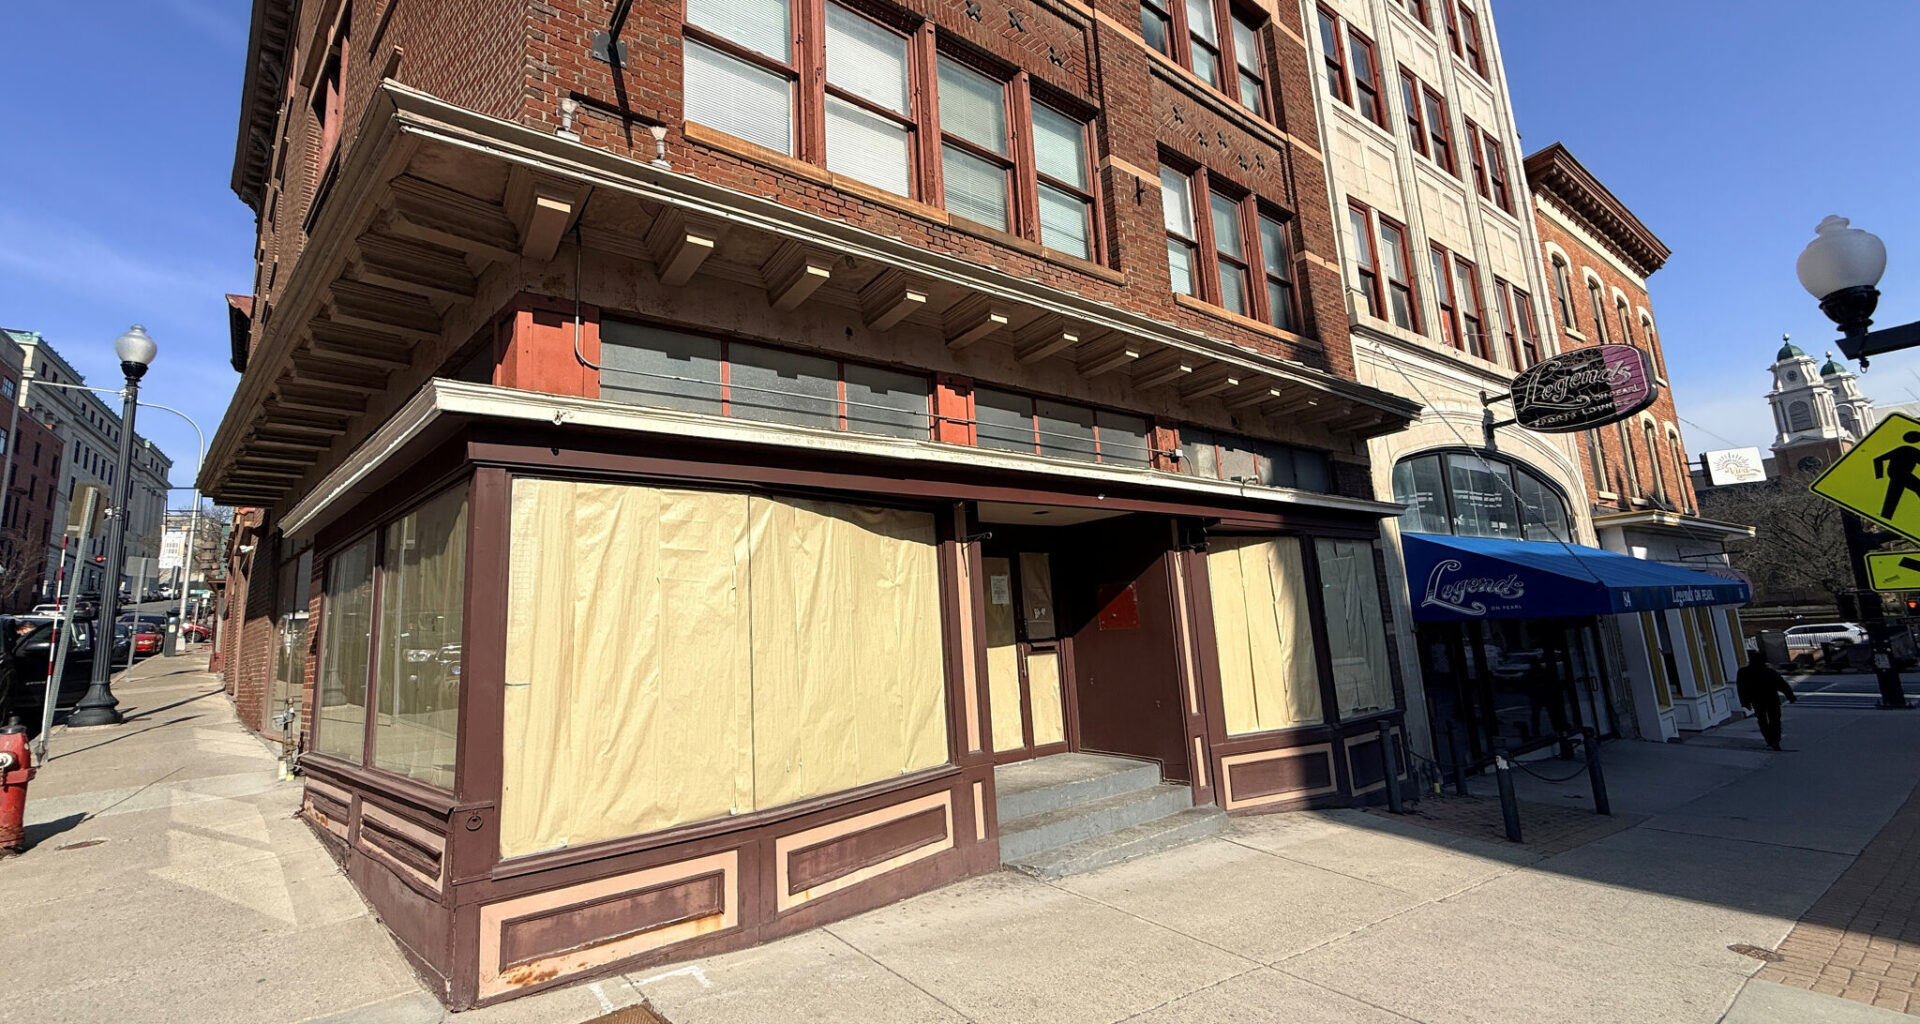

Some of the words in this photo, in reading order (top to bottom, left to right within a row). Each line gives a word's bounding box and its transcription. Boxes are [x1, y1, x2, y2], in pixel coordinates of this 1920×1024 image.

[1518, 359, 1631, 412] Legends
[1609, 384, 1640, 396] PEARL
[1533, 413, 1578, 426] SPORTS
[1581, 398, 1632, 414] LOUNGE
[1421, 560, 1524, 615] Legends
[1671, 585, 1694, 607] Legends
